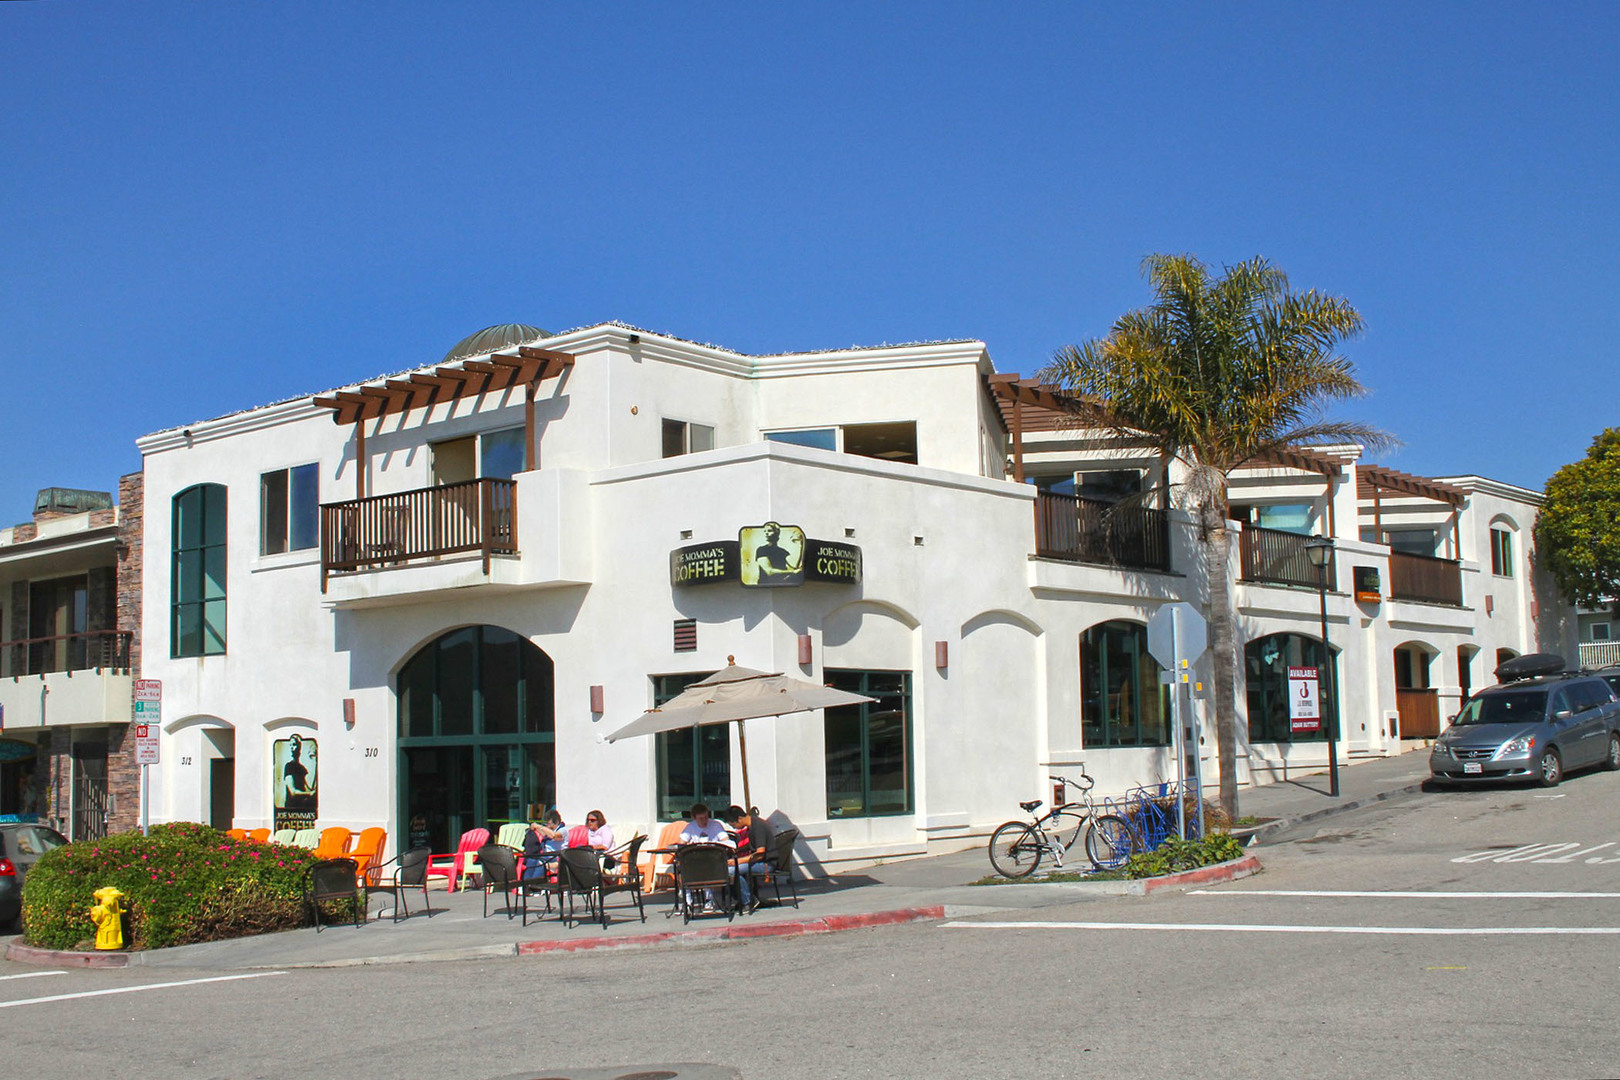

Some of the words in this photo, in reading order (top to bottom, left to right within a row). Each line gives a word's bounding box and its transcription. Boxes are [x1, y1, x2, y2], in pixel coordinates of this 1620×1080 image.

[817, 546, 833, 557] JOE
[675, 558, 725, 581] COFFEE
[1290, 669, 1317, 678] AVAILABLE
[365, 747, 379, 758] 310
[181, 756, 192, 766] 312
